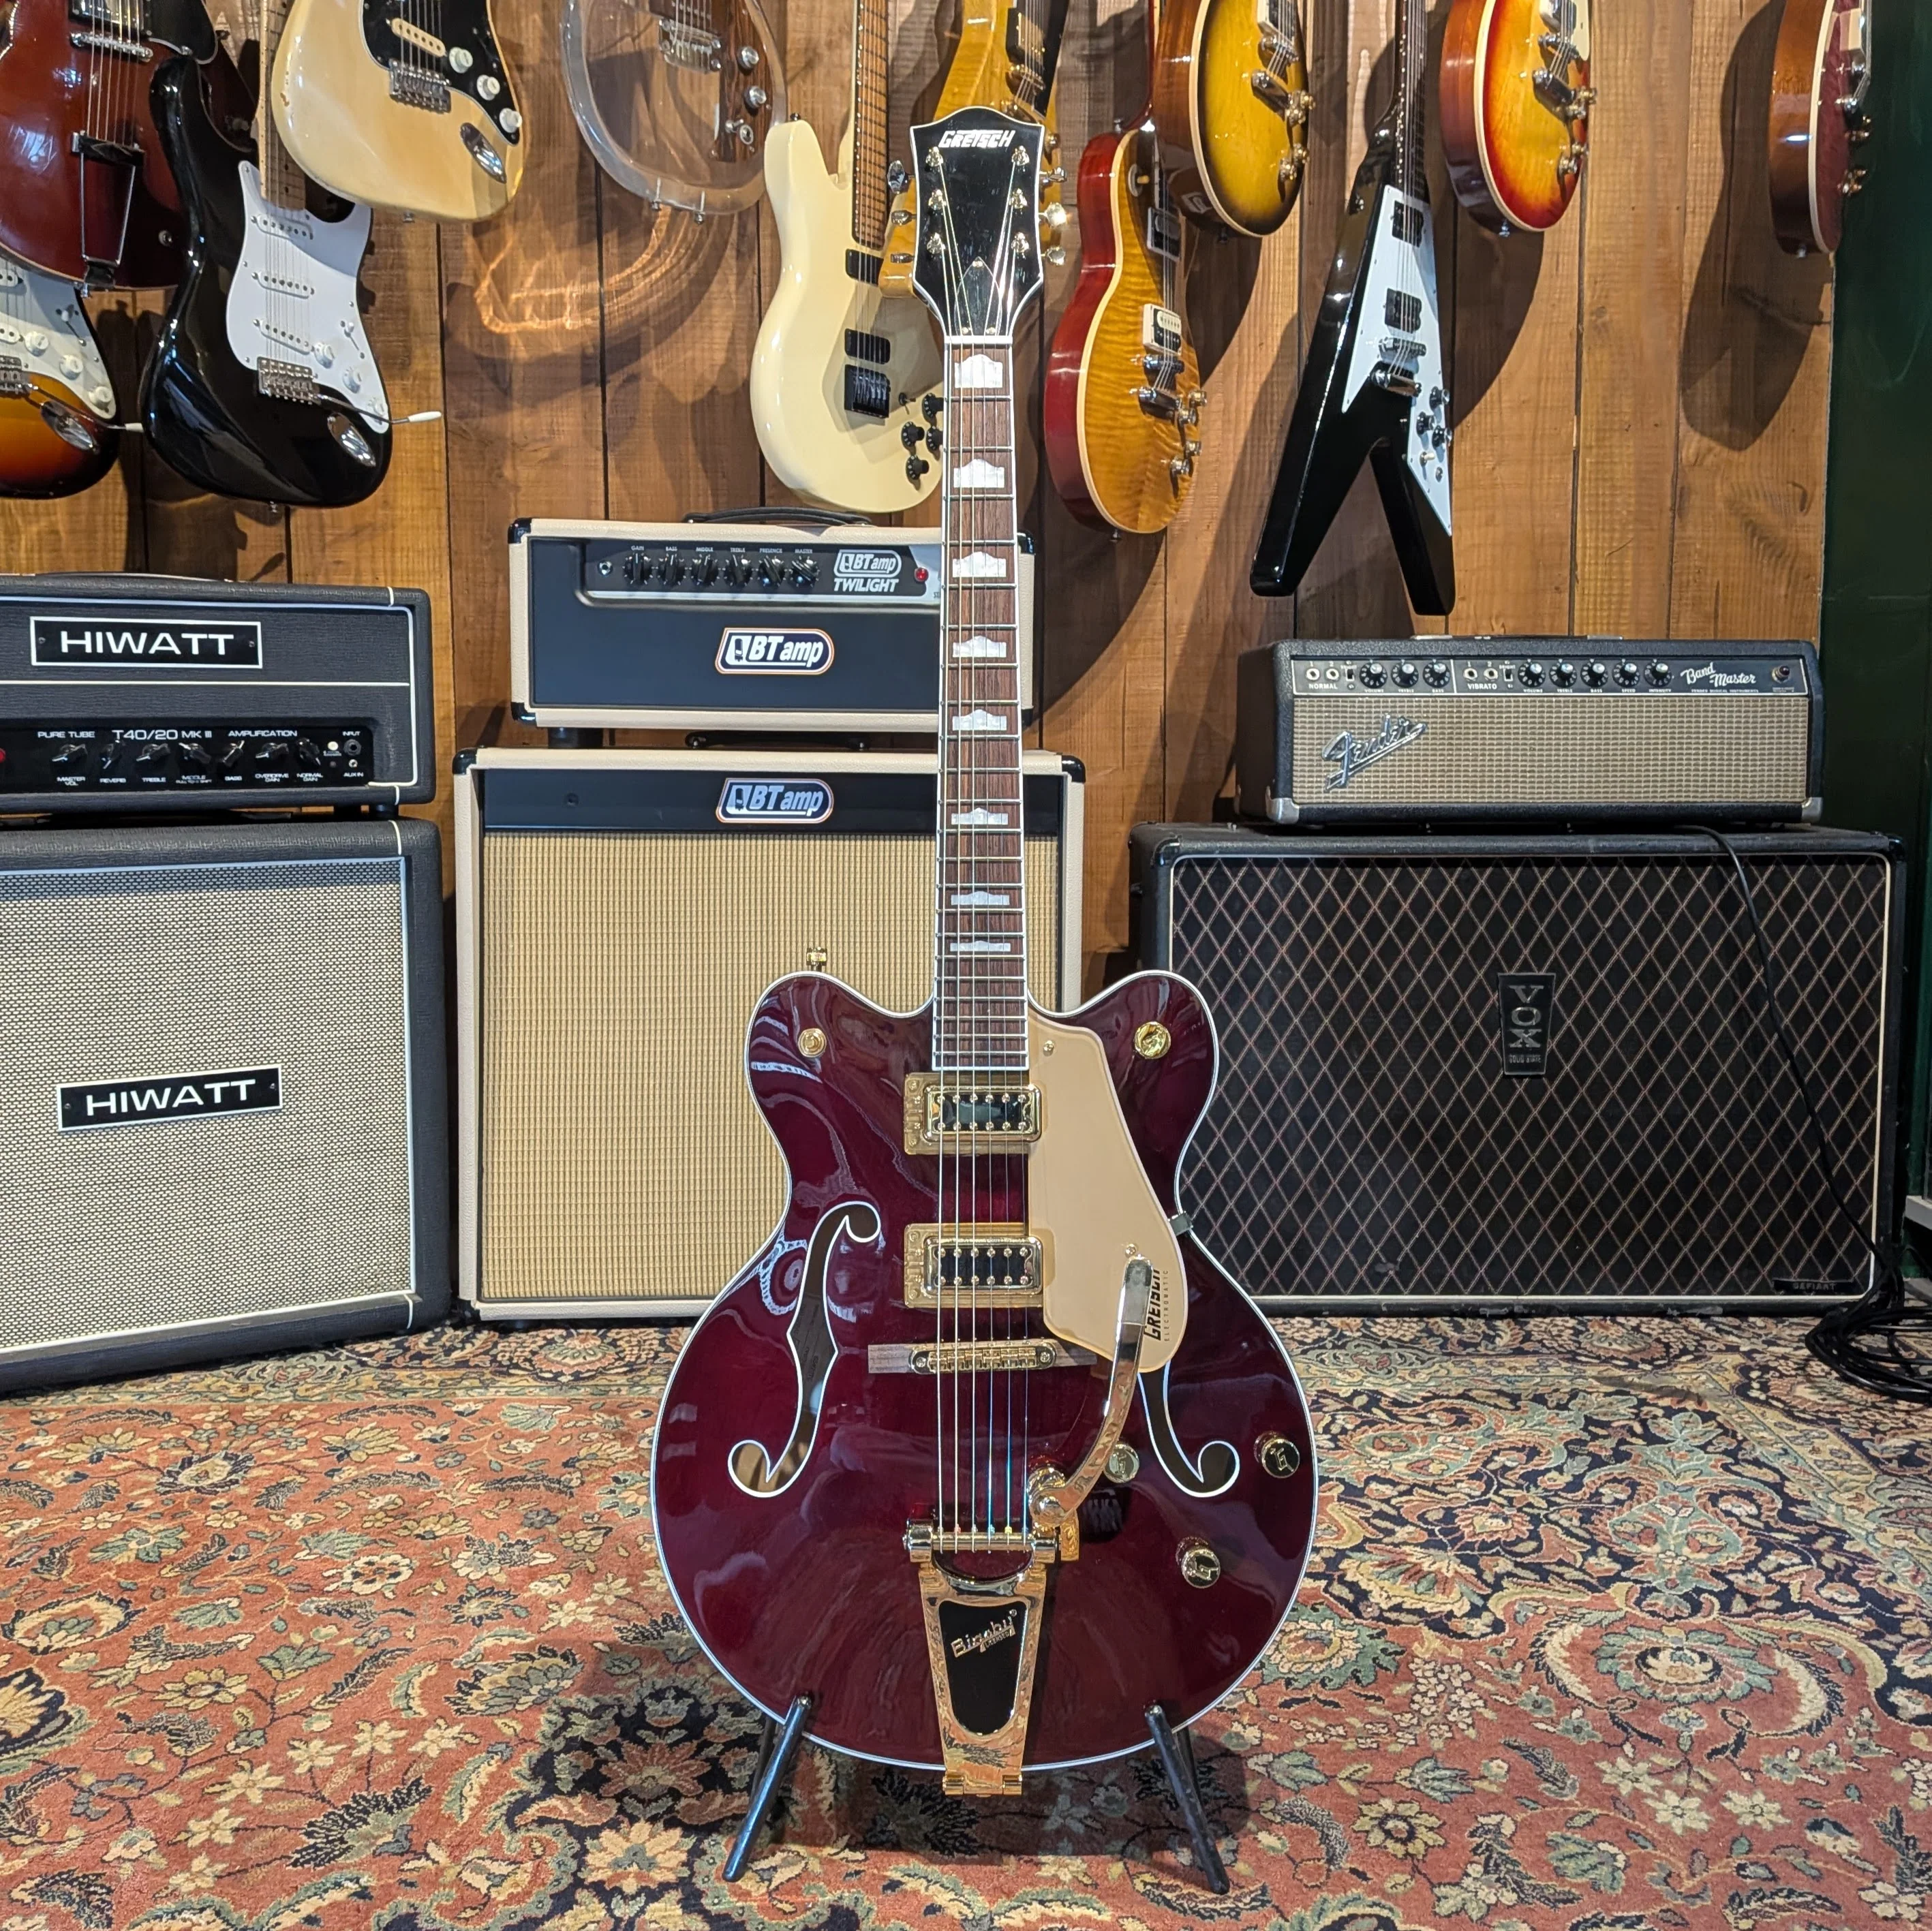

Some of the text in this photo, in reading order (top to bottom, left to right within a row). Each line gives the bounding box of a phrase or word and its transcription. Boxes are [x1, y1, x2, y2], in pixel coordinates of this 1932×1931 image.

[938, 129, 1015, 148] GRETSCH
[833, 578, 899, 592] TWILIGHT
[61, 630, 234, 655] HIWATT
[1680, 662, 1716, 685] Band
[1710, 672, 1756, 688] Master
[112, 730, 178, 740] T40/20
[181, 730, 202, 739] MK
[1321, 713, 1428, 792] Fender
[1508, 985, 1544, 1048] VOX
[86, 1079, 256, 1117] HIWATT
